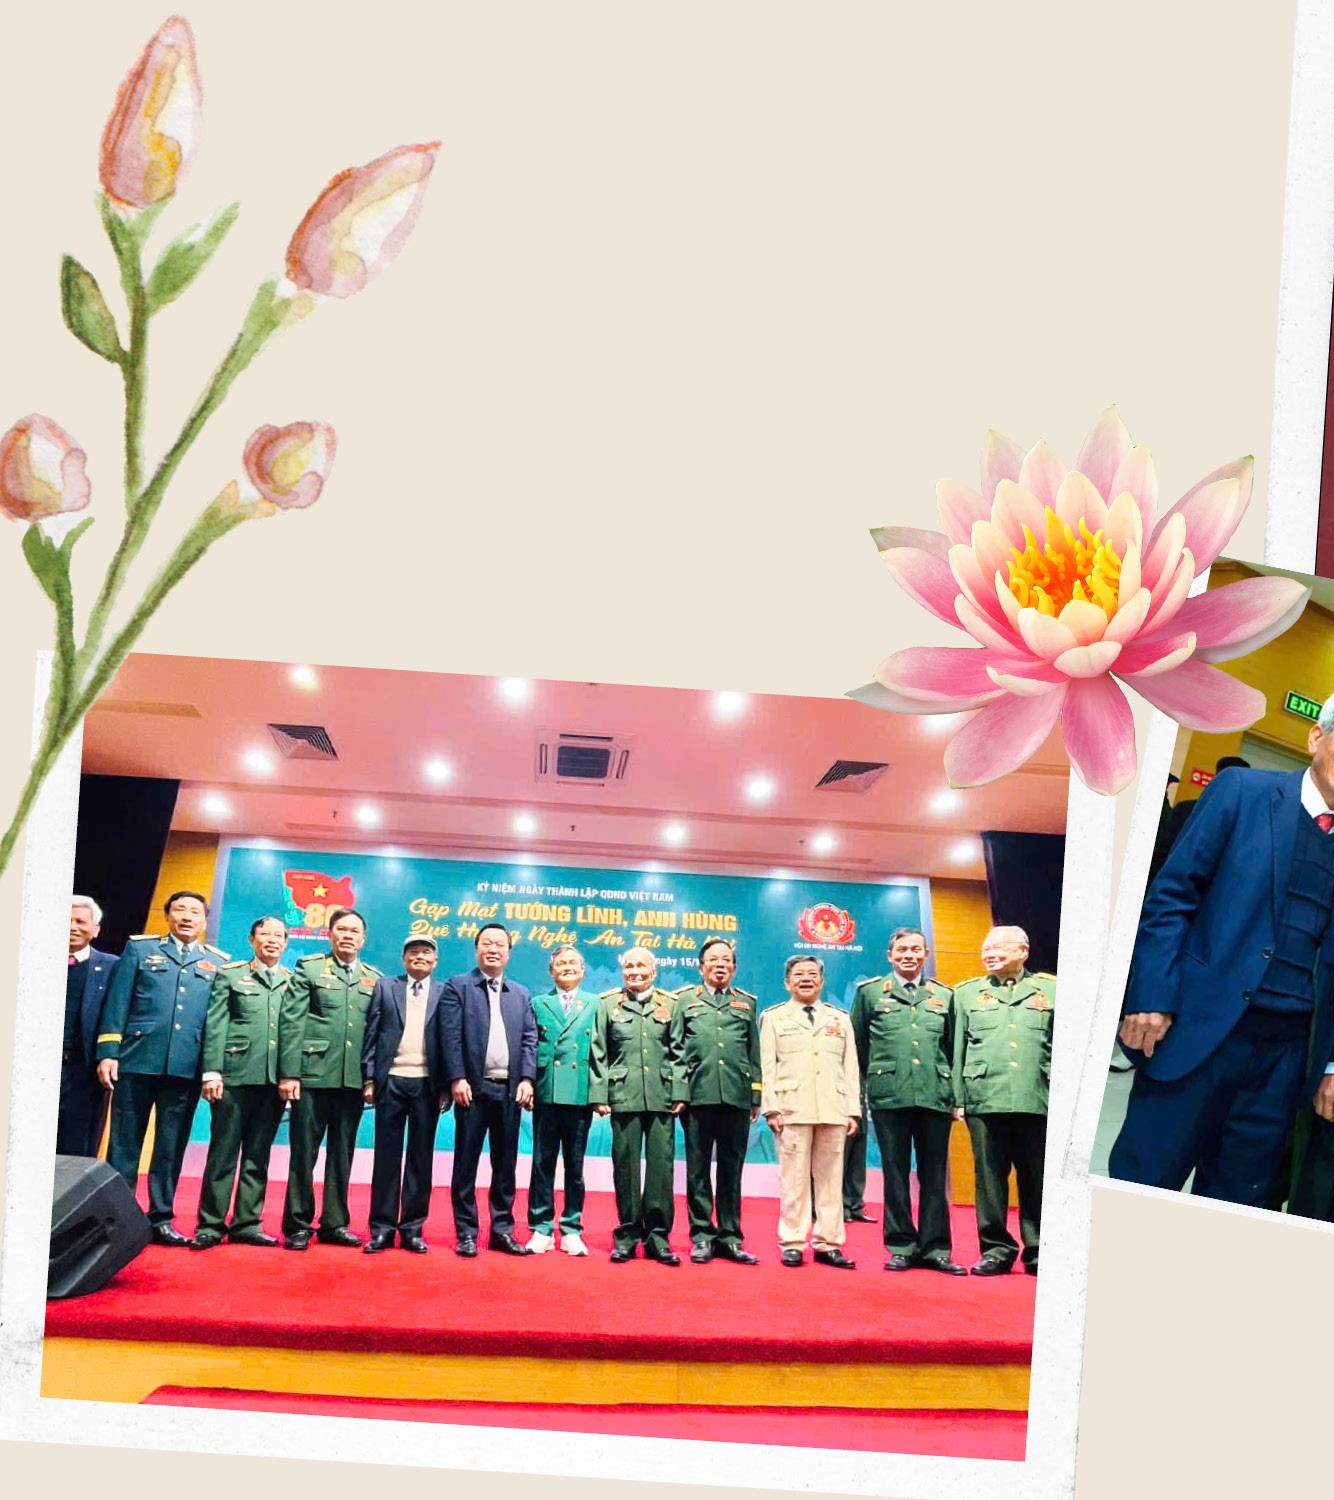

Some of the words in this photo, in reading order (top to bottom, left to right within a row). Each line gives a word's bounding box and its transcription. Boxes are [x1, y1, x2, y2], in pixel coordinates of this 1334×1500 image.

[1290, 695, 1320, 718] EXIT
[652, 892, 674, 902] NAM
[504, 900, 571, 922] TƯỚNG
[577, 904, 628, 927] LĨNH,
[633, 909, 677, 928] ANH
[682, 910, 738, 931] HÙNG
[528, 925, 578, 949] Nghệ
[583, 929, 625, 945] An
[666, 932, 697, 950] Hà
